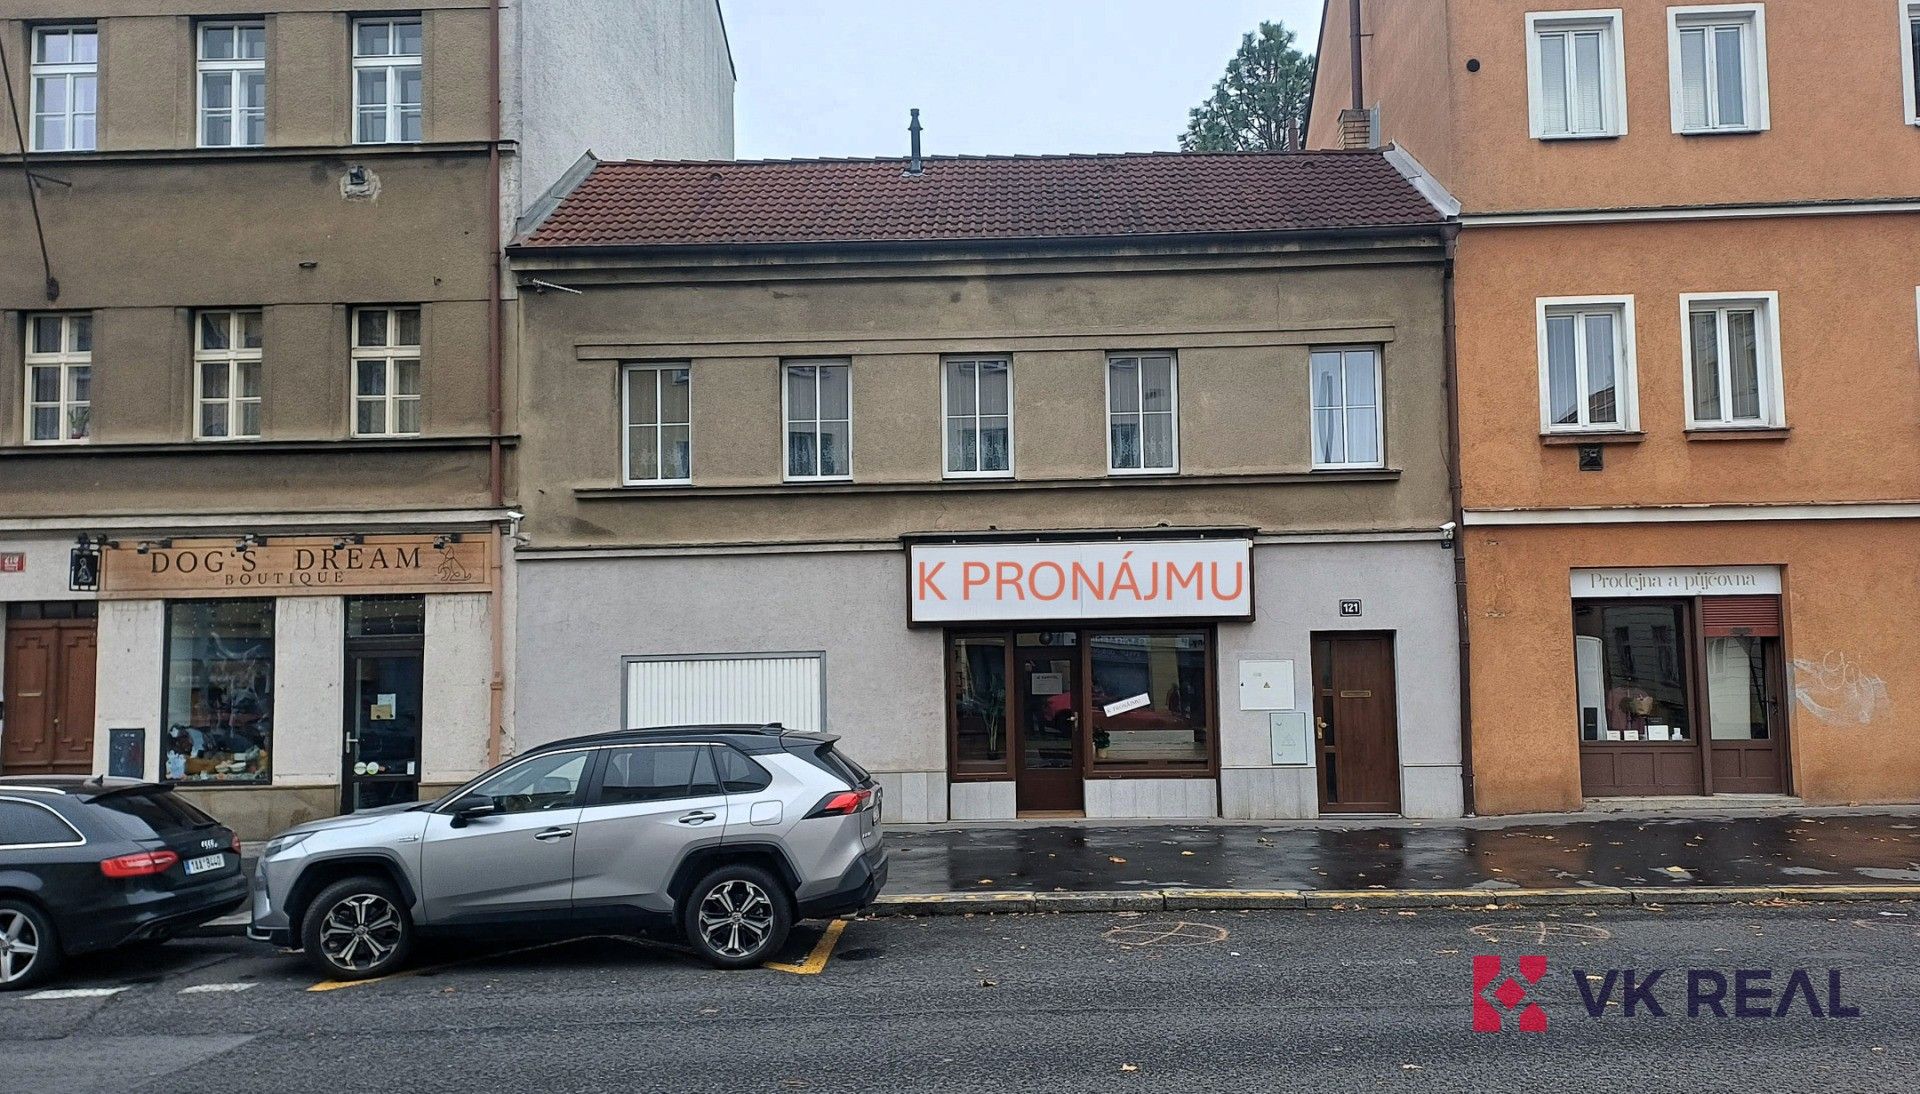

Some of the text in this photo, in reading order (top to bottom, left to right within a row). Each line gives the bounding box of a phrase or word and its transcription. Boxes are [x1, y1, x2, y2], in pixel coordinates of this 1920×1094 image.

[295, 546, 422, 571] DREAM
[225, 571, 344, 587] BOUTIQUE
[918, 550, 1243, 601] K PRONÁJMU
[1590, 572, 1662, 591] Prodejna
[1668, 577, 1679, 588] a
[1343, 602, 1359, 613] 121
